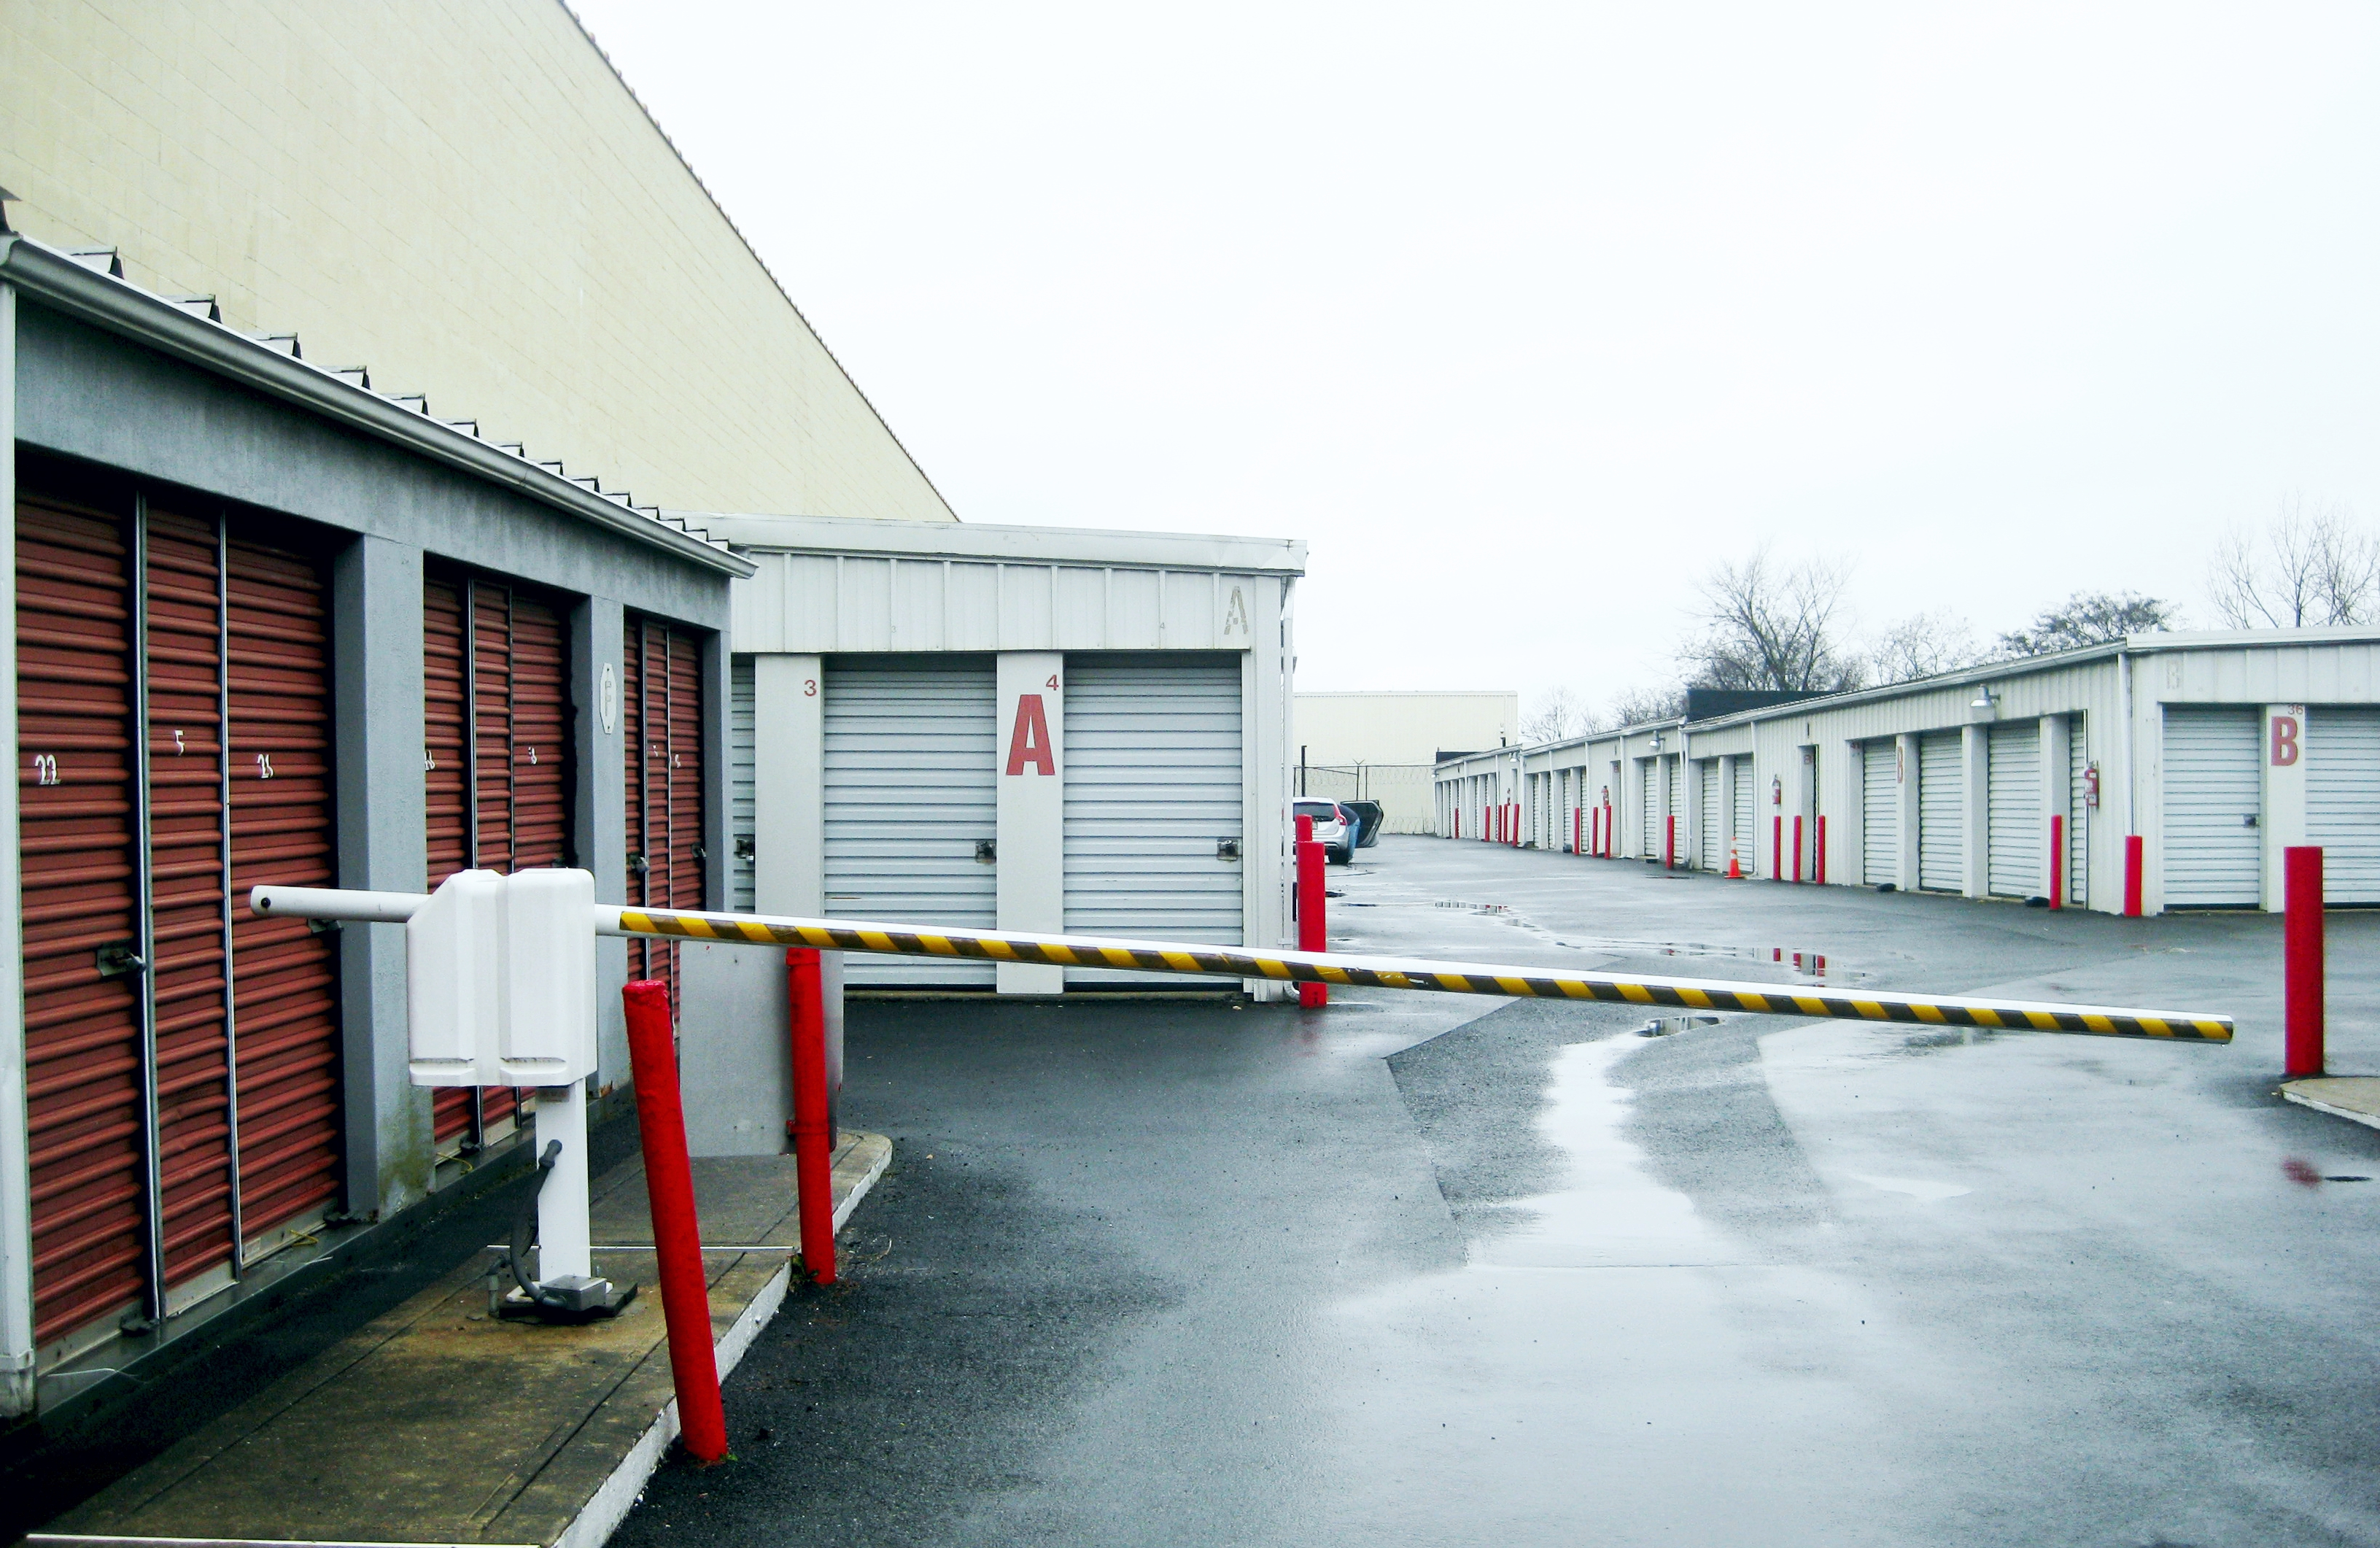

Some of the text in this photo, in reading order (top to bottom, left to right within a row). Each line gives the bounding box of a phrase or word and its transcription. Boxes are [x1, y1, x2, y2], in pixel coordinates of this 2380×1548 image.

[1224, 586, 1248, 635] A
[804, 679, 817, 697] 3
[1045, 674, 1059, 691] 4
[2287, 704, 2304, 715] 36
[1006, 694, 1055, 775] A
[2271, 716, 2298, 766] B
[34, 754, 61, 786] 22
[1897, 746, 1903, 783] B
